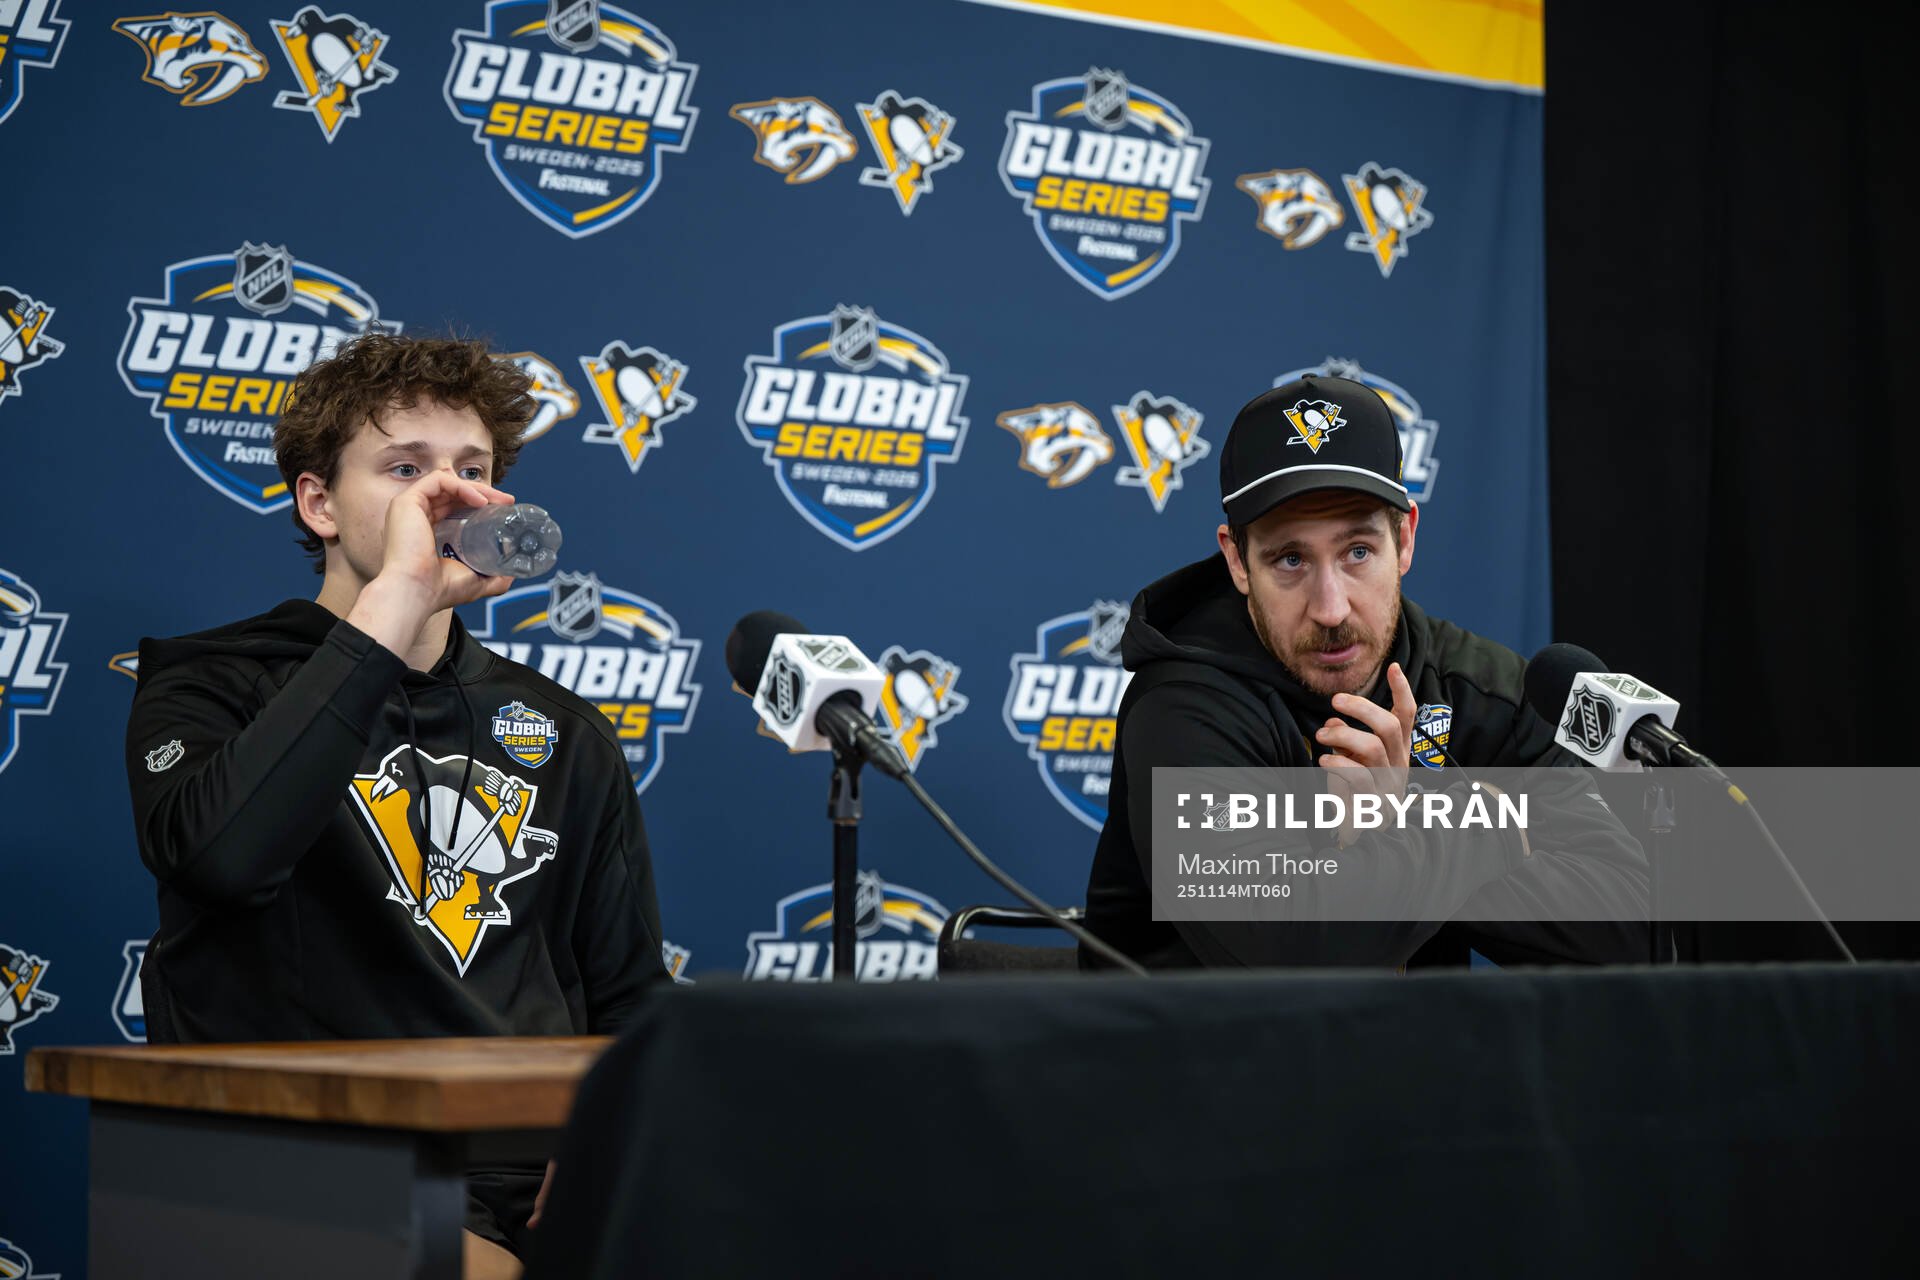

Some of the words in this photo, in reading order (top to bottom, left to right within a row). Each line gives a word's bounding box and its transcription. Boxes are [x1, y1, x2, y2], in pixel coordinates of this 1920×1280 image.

[452, 40, 687, 130] GLOBAL
[484, 101, 650, 154] SERIES
[1007, 120, 1200, 200] GLOBAL
[1034, 175, 1170, 223] SERIES
[249, 264, 284, 298] NHL
[744, 365, 958, 441] GLOBAL
[774, 422, 925, 467] SERIES
[494, 719, 555, 737] GLOBAL
[504, 735, 546, 746] SERIES
[1584, 701, 1600, 743] NHL
[157, 748, 176, 768] NHL
